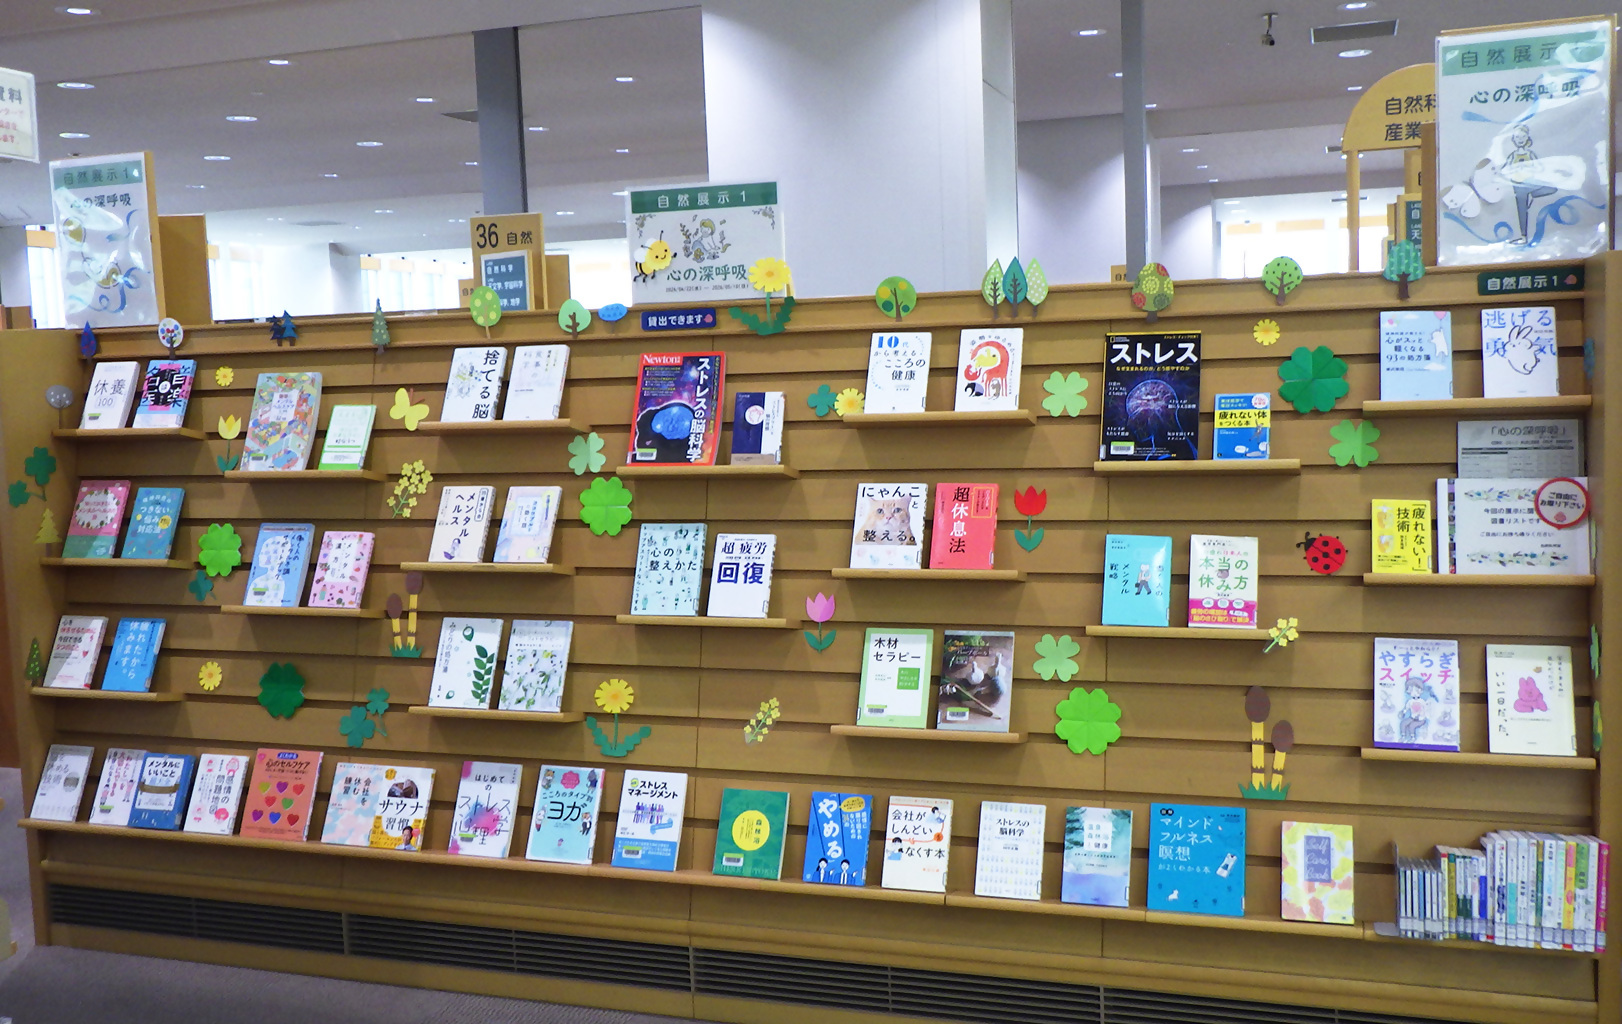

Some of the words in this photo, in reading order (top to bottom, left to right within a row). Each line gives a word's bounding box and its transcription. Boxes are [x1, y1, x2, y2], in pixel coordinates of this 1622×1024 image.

[657, 190, 748, 210] 自然展示1
[476, 223, 499, 248] 36
[506, 231, 533, 245] 自然
[666, 264, 749, 282] 心の深呼吸
[1487, 276, 1558, 290] 自然展示1
[648, 314, 702, 327] 貸出できます
[1484, 309, 1552, 328] 逃げる
[642, 355, 681, 364] Newton
[1110, 342, 1199, 365] ストレス
[885, 359, 926, 368] こころの
[891, 371, 916, 381] 健康
[472, 350, 500, 419] 捨てる脳
[686, 358, 711, 462] ストレスの脳科学
[1219, 411, 1267, 420] 疲れない体
[862, 486, 920, 498] にゃんこ
[450, 495, 464, 525] ヘルス
[459, 493, 475, 537] メンタル
[949, 487, 970, 554] 超休息法
[1397, 507, 1410, 532] 技術
[863, 530, 915, 542] 整える。
[650, 547, 674, 557] 心の
[721, 541, 768, 555] 超疲労
[649, 560, 697, 571] 整えかた
[1199, 557, 1248, 571] 本当の
[717, 562, 765, 584] 回復
[1121, 564, 1129, 594] メンタル
[1199, 574, 1248, 592] 休み方
[874, 637, 898, 649] 木材
[873, 651, 921, 662] セラピー
[1379, 651, 1456, 669] やすらぎ
[1379, 668, 1454, 685] スイッチ
[475, 774, 505, 783] はじめて
[639, 781, 668, 790] ストレス
[361, 777, 371, 806] 会社を
[627, 789, 678, 799] マネージメント
[379, 799, 423, 816] サウナ
[458, 793, 511, 816] ストレス
[547, 801, 587, 822] ヨガ
[892, 809, 926, 821] 会社が
[891, 824, 933, 835] しんどい
[996, 818, 1030, 827] ストレスの
[1160, 816, 1214, 830] マインド
[1160, 831, 1213, 846] フルネス
[905, 847, 946, 859] なくす本
[1158, 845, 1191, 861] 瞑想
